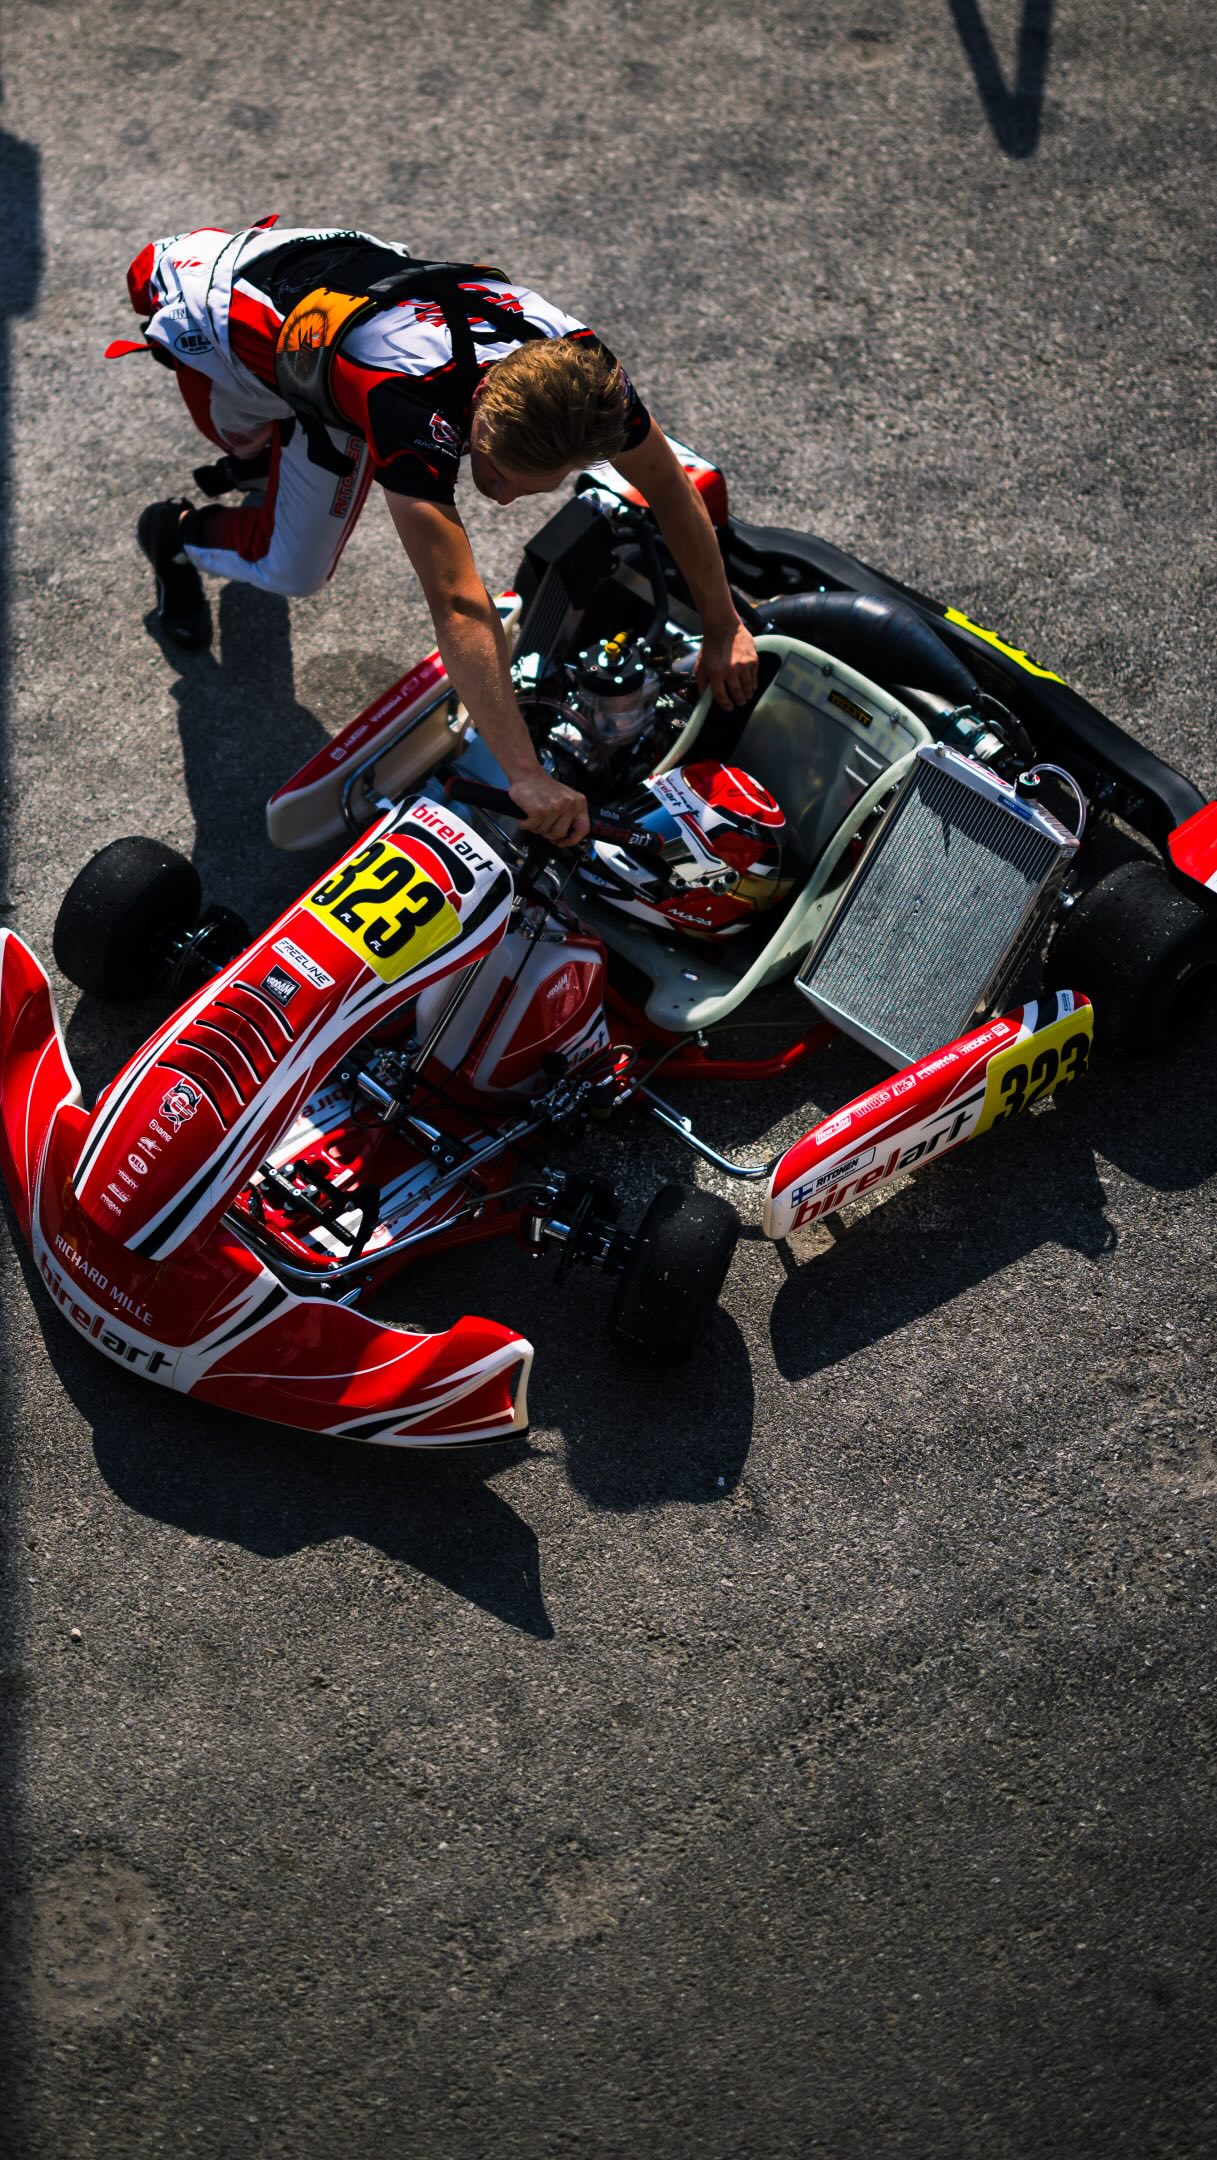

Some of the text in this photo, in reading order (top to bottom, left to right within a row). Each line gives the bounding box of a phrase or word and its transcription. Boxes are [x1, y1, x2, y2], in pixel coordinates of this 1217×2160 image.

[333, 439, 362, 516] RITOEN
[412, 804, 495, 872] birelart
[311, 842, 446, 959] 323
[279, 940, 331, 984] FREELINE
[130, 1155, 145, 1172] BELL
[790, 1110, 974, 1232] birelart
[816, 1157, 860, 1188] RITONEN
[40, 1252, 173, 1374] birelart
[55, 1233, 153, 1326] RICHARD MILLE
